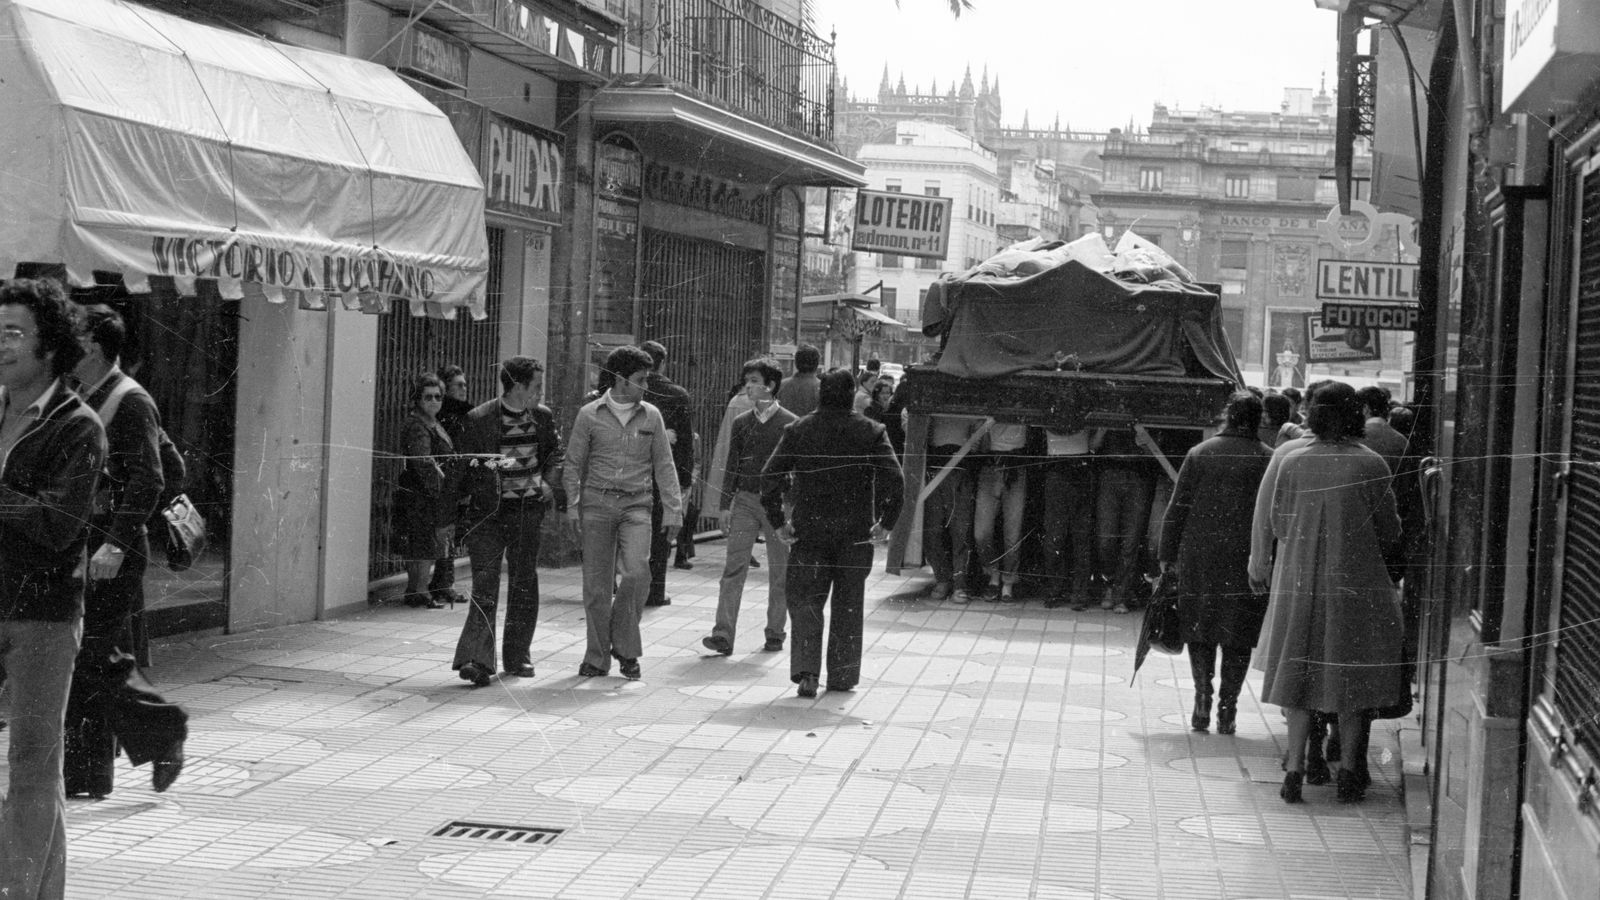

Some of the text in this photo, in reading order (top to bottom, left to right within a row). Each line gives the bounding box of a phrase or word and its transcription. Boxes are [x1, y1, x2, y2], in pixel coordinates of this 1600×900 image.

[487, 123, 561, 213] PHILDAR
[859, 195, 944, 232] LOTERIA
[1220, 216, 1368, 232] BANCO DE EAÑA
[152, 236, 295, 285] VICTORIO
